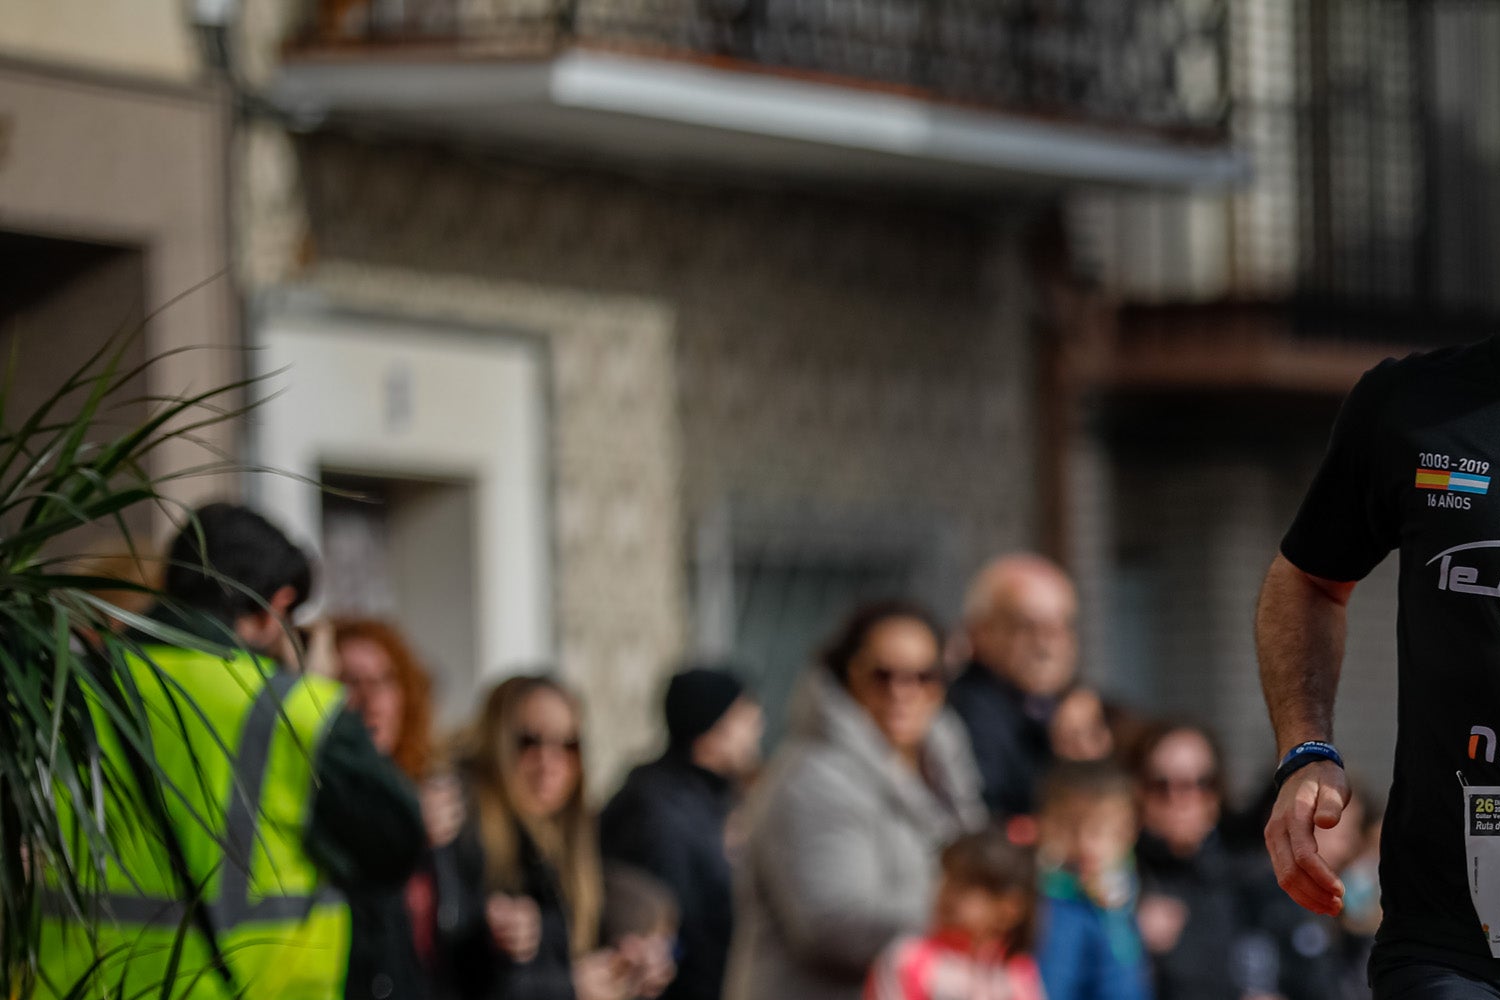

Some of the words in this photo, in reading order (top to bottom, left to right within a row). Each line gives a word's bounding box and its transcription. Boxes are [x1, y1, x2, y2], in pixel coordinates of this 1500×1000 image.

[1427, 493, 1437, 507] 16
[1437, 492, 1471, 510] AÑOS
[1475, 798, 1494, 813] 26
[1476, 821, 1493, 830] Ruta
